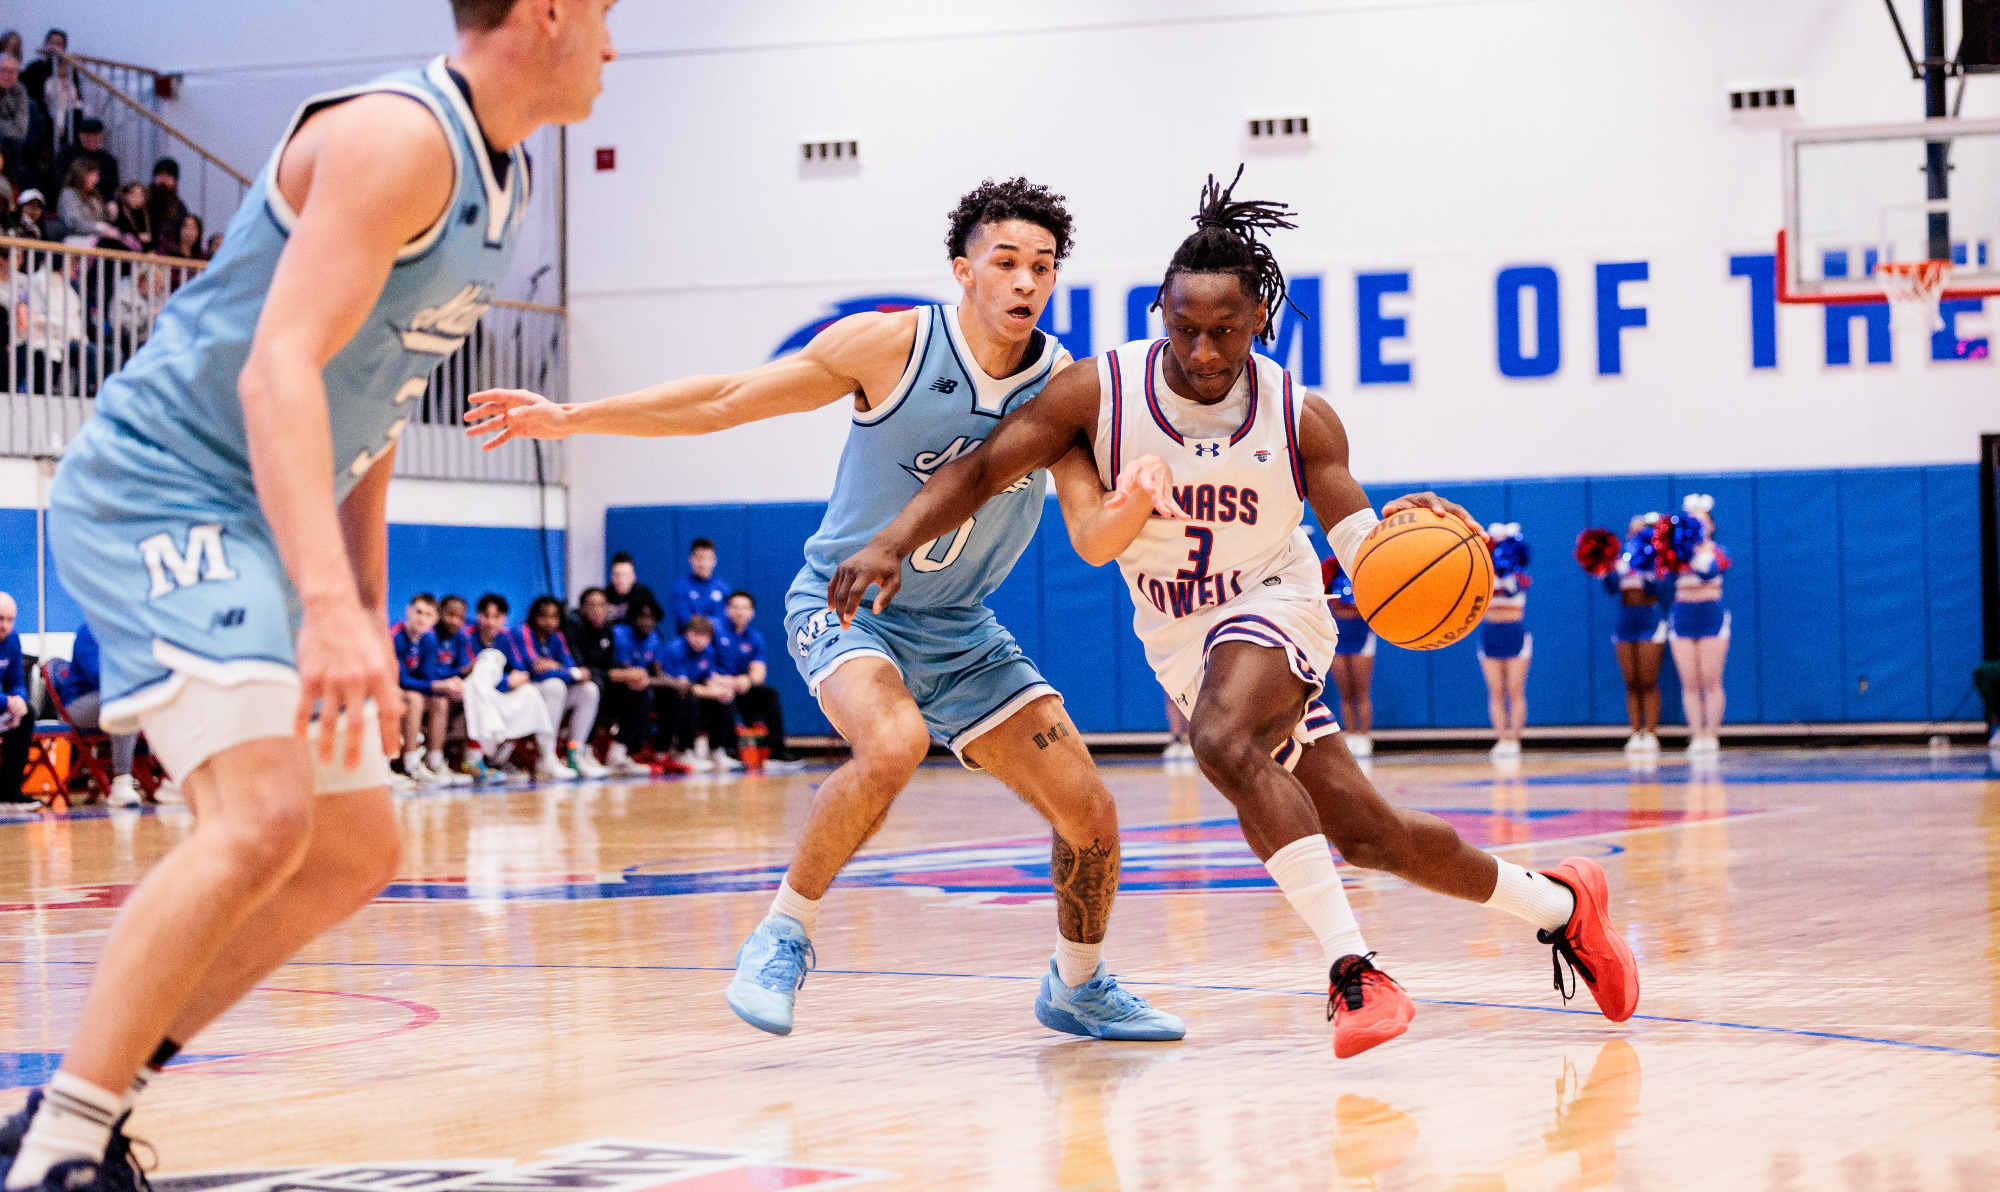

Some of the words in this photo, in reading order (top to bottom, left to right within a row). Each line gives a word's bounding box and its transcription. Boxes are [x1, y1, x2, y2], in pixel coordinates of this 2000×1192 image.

[1496, 261, 1650, 377] OF
[1729, 242, 1990, 368] THE
[1153, 484, 1259, 526] MASS
[136, 522, 240, 600] M
[908, 515, 978, 574] 0
[1176, 525, 1214, 581] 3
